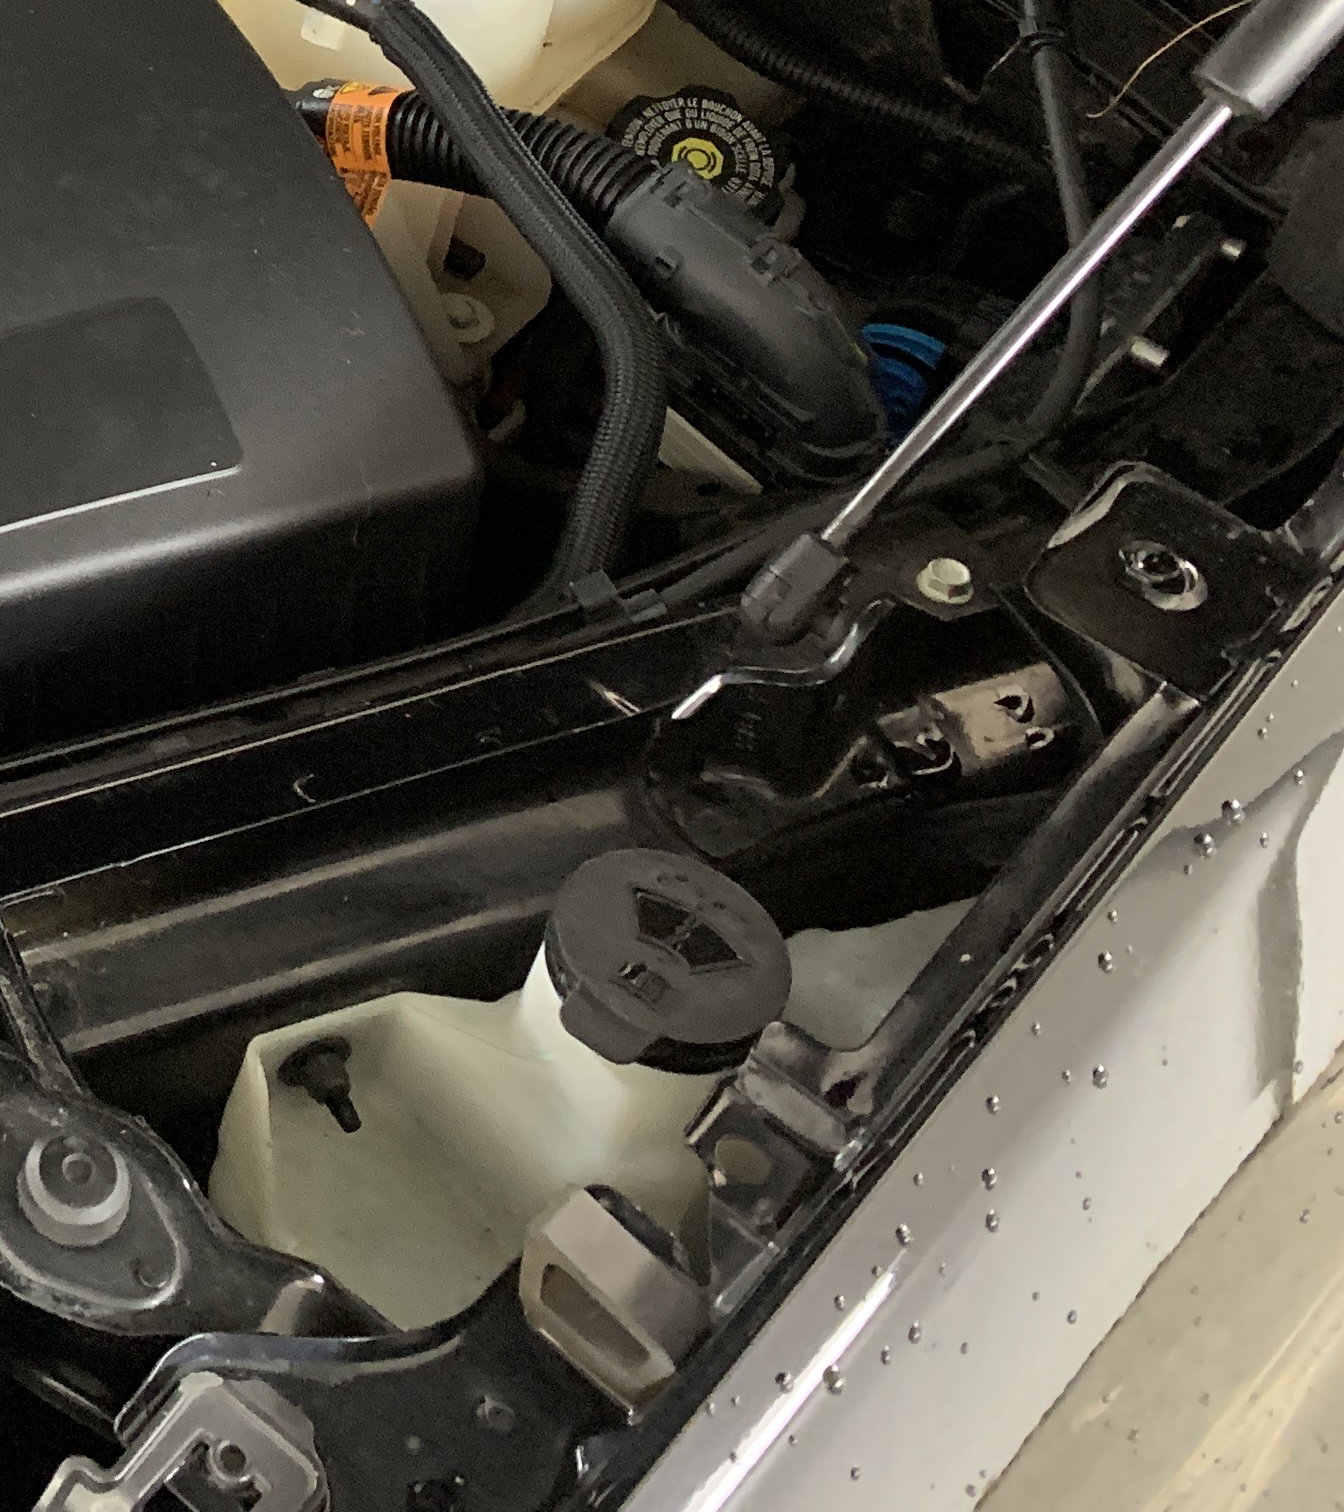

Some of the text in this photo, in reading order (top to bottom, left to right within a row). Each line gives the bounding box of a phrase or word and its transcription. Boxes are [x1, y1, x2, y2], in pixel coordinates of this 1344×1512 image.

[685, 108, 698, 118] DU
[687, 97, 698, 107] LE
[701, 99, 744, 123] BOUCHON
